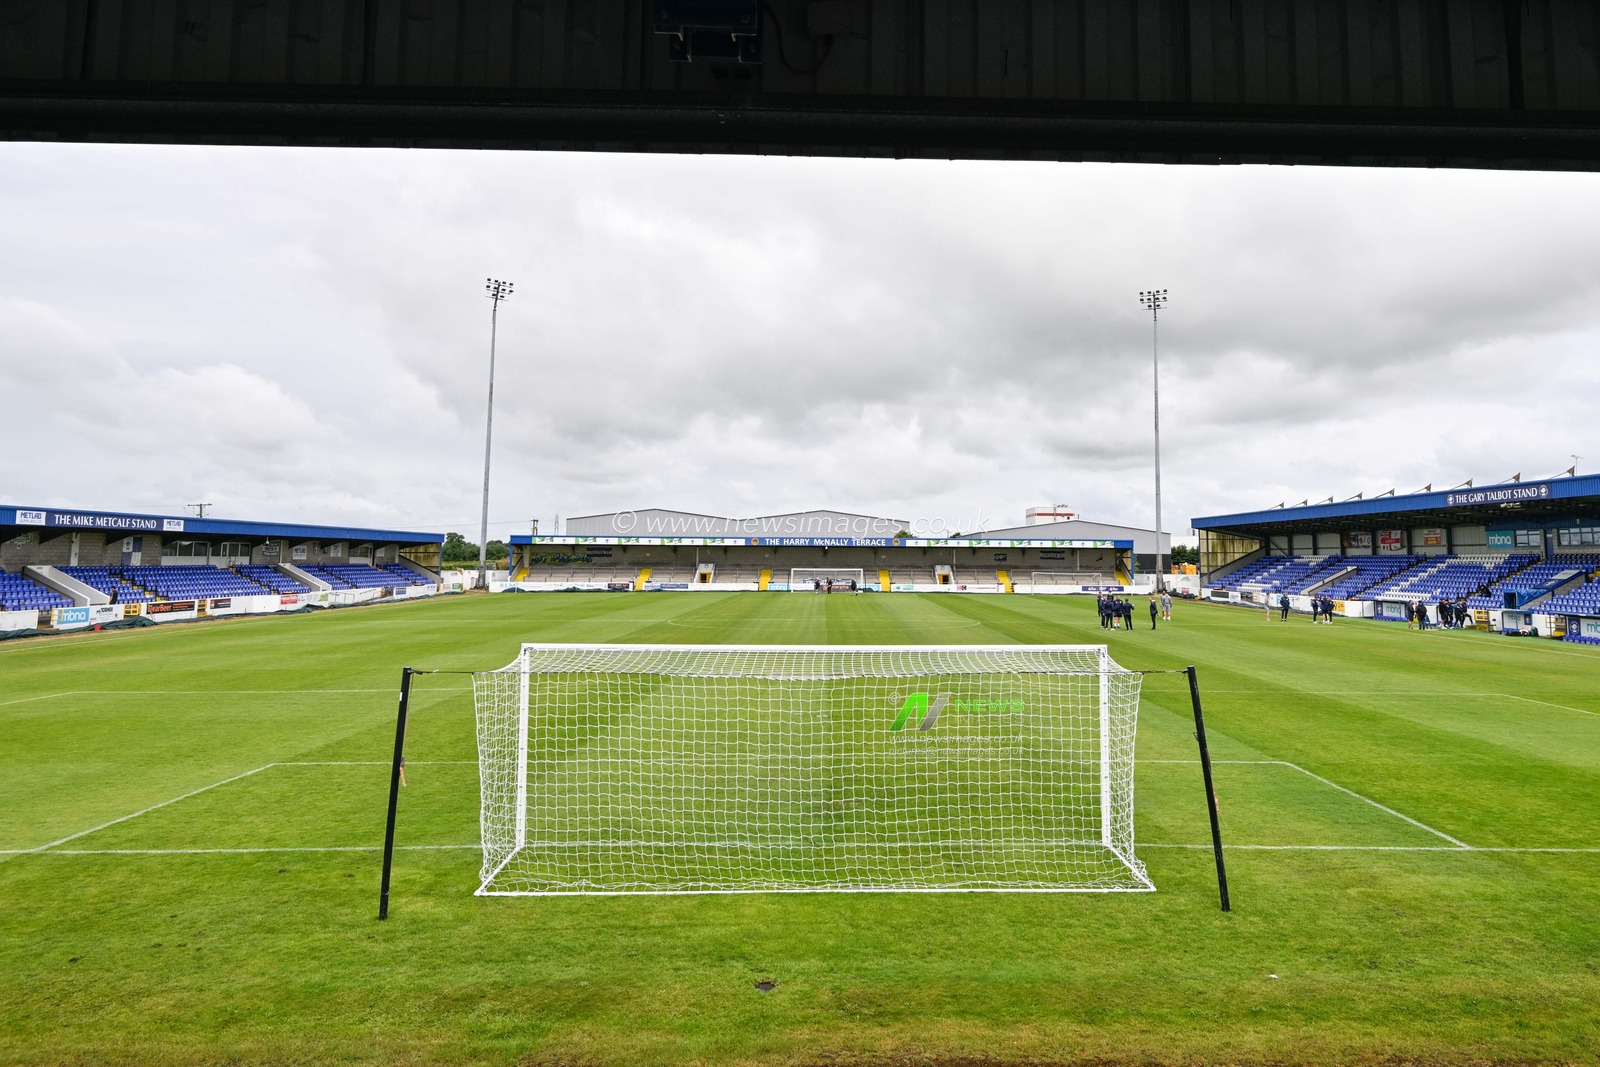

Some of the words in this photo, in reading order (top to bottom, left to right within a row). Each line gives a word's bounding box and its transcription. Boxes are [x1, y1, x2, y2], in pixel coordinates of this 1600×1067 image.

[1455, 495, 1467, 503] THE
[1468, 493, 1485, 502] GARY
[1486, 490, 1512, 502] TALBOT
[1513, 488, 1538, 499] STAND
[20, 512, 42, 520] METLAB
[54, 514, 71, 525] THE
[73, 516, 94, 526] MIKE
[95, 516, 130, 528] METCALF
[132, 518, 156, 529] STAND
[1489, 534, 1512, 545] mbna
[1386, 605, 1401, 614] mbna
[63, 610, 86, 621] mbna
